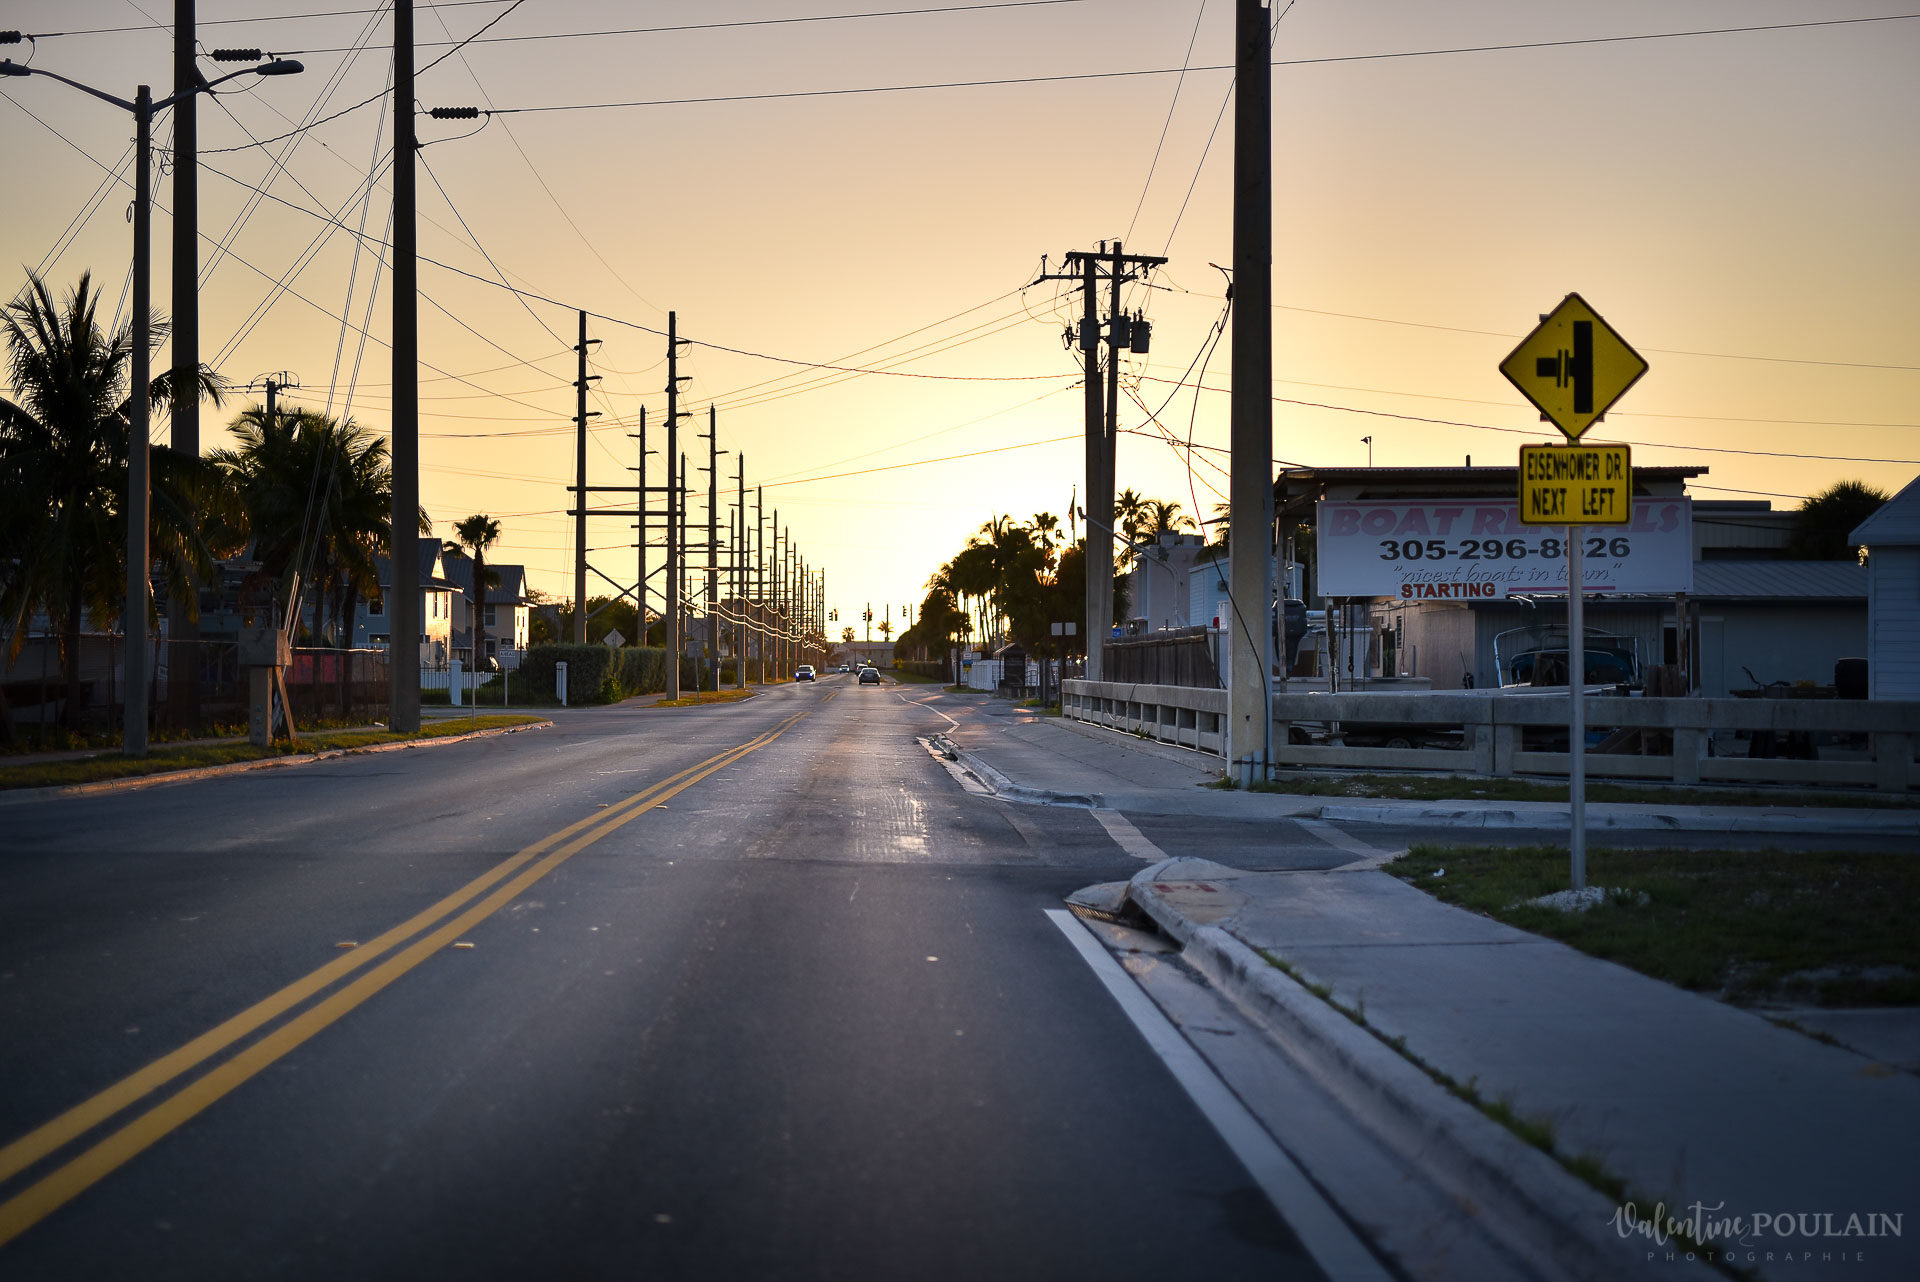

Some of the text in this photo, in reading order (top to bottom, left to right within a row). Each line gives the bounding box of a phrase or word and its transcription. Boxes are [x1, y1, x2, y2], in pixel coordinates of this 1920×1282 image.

[1527, 453, 1623, 480] EISENHOWER DR.
[1532, 488, 1615, 515] NEXT LEFT
[1328, 504, 1680, 536] BOAT RELS
[1466, 563, 1523, 583] boats
[1528, 567, 1549, 582] in
[1556, 563, 1622, 582] twn"
[1401, 582, 1496, 599] STARTING
